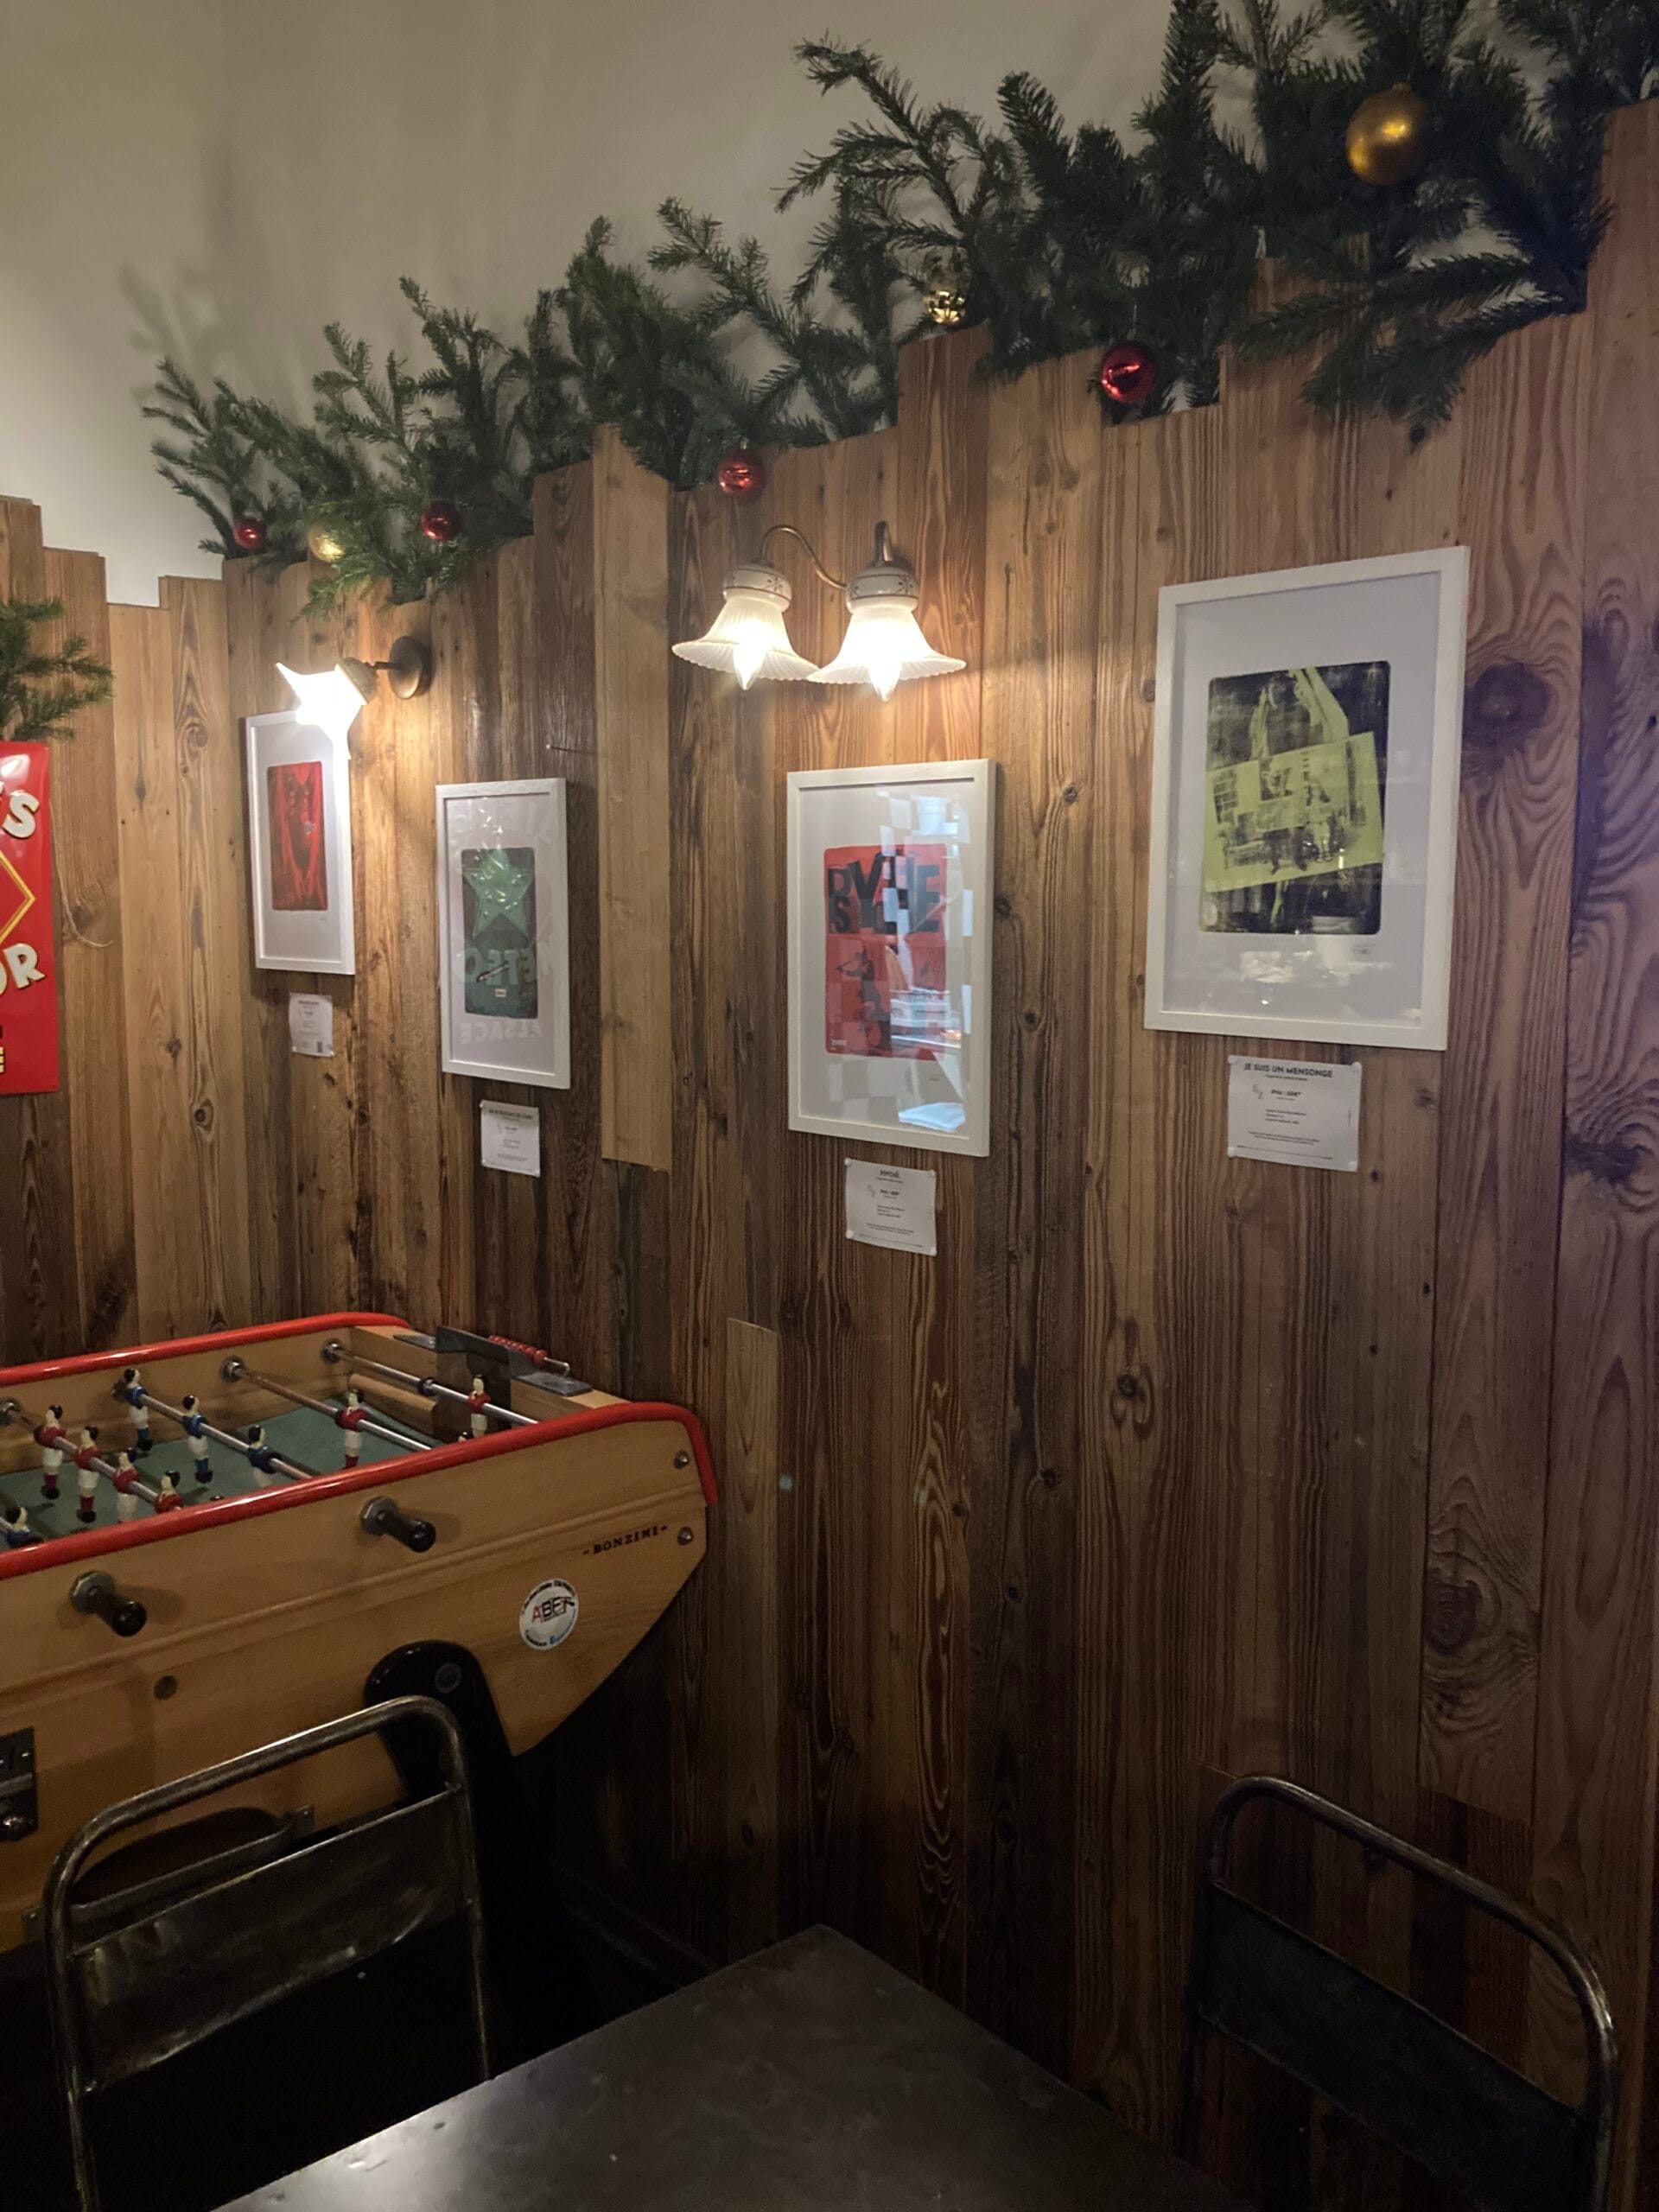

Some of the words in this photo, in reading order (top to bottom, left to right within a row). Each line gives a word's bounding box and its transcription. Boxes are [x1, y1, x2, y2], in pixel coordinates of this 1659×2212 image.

[0, 780, 40, 839] S
[1254, 1063, 1270, 1072] SUIS
[1272, 1065, 1284, 1073] UN
[1286, 1067, 1333, 1078] MENSONGE
